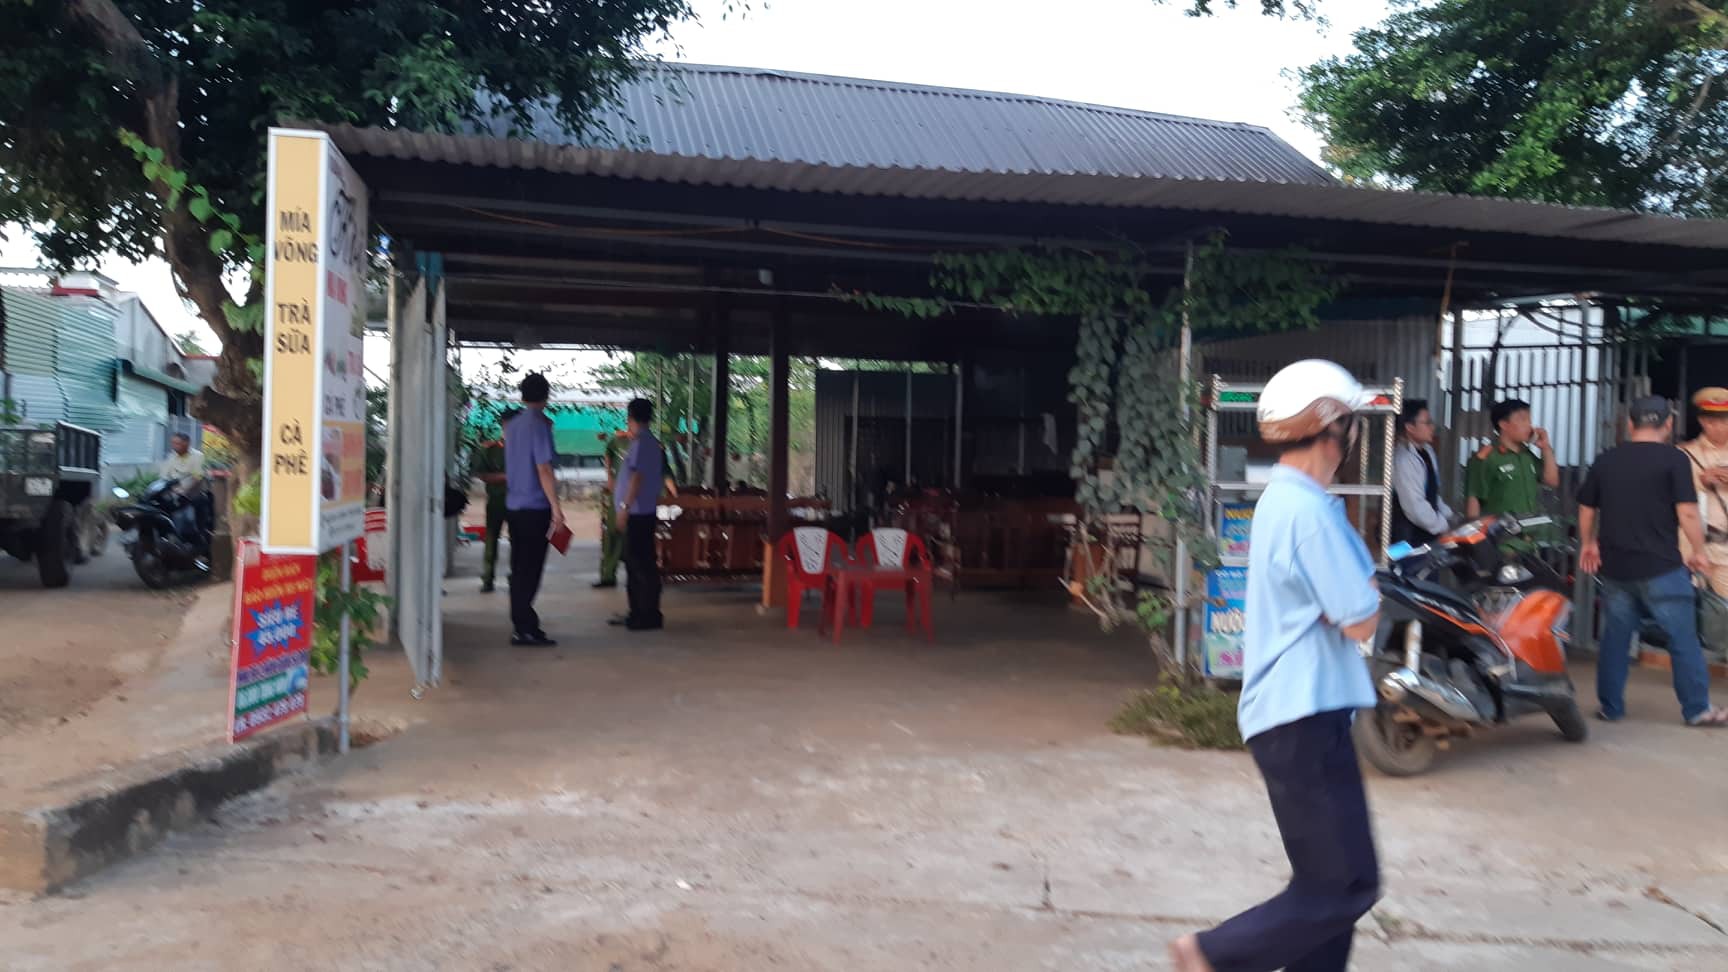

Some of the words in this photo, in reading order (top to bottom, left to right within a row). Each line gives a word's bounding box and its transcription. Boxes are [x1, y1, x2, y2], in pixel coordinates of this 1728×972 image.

[280, 206, 312, 233] MÍA
[277, 297, 311, 325] TRÀ
[277, 328, 311, 355] SỮA
[279, 417, 303, 446] CÀ
[273, 448, 308, 476] PHÊ
